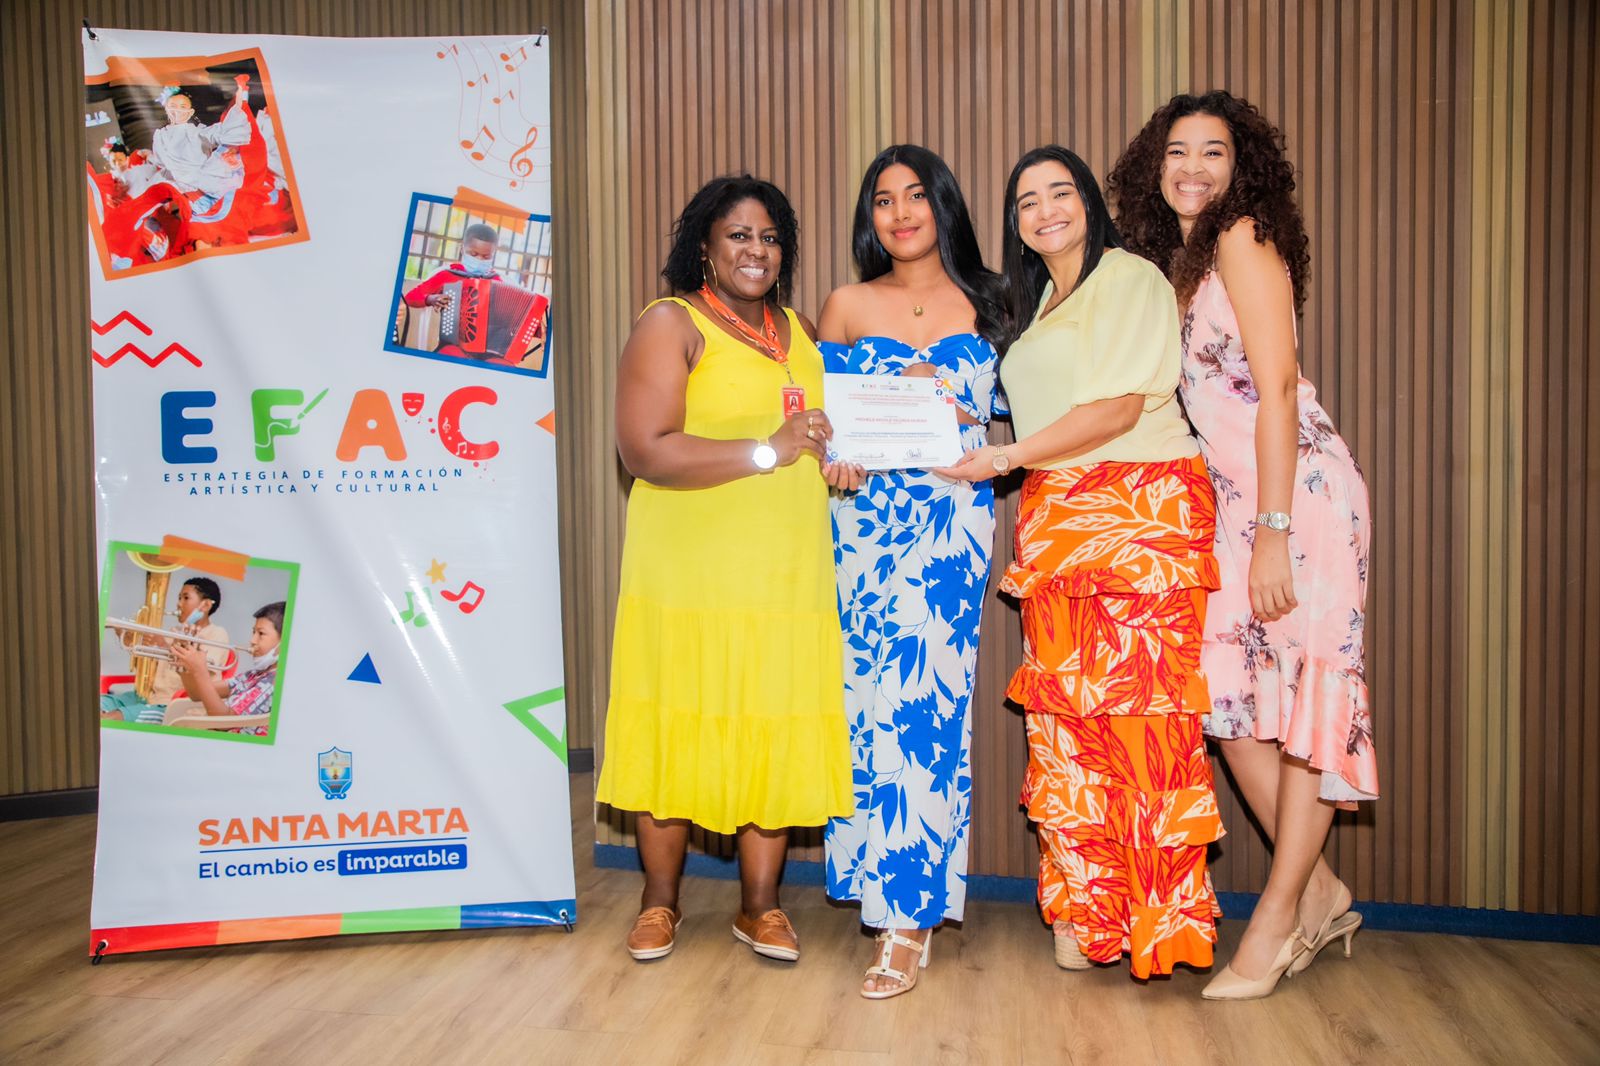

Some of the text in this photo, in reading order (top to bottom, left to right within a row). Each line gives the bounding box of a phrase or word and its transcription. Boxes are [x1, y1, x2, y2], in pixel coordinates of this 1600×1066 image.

[164, 467, 463, 482] ESTRATEGIA DE FORMACIÓN
[190, 483, 439, 495] ARTÍSTICA Y CULTURAL
[198, 807, 470, 846] SANTA MARTA
[199, 849, 460, 878] El cambio es imparable
